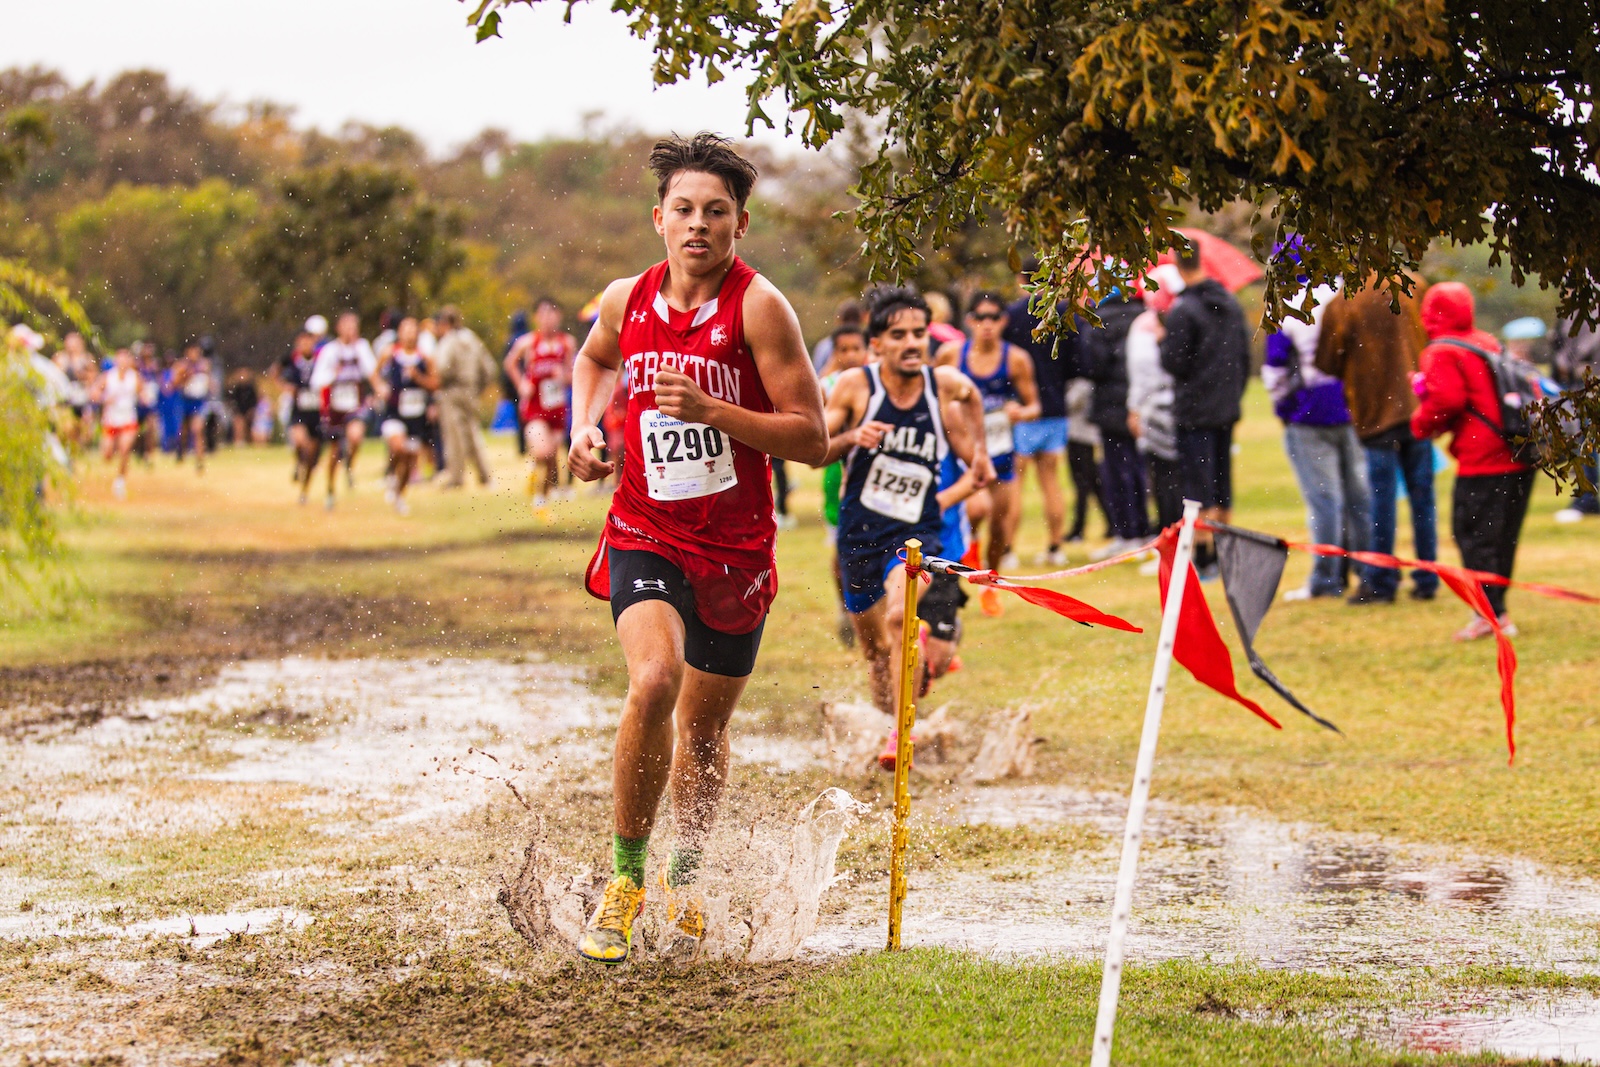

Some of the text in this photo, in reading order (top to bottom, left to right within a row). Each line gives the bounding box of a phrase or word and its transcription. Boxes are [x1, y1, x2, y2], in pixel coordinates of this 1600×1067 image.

[647, 426, 723, 464] 1290
[880, 426, 936, 462] MLA
[872, 469, 923, 498] 1259
